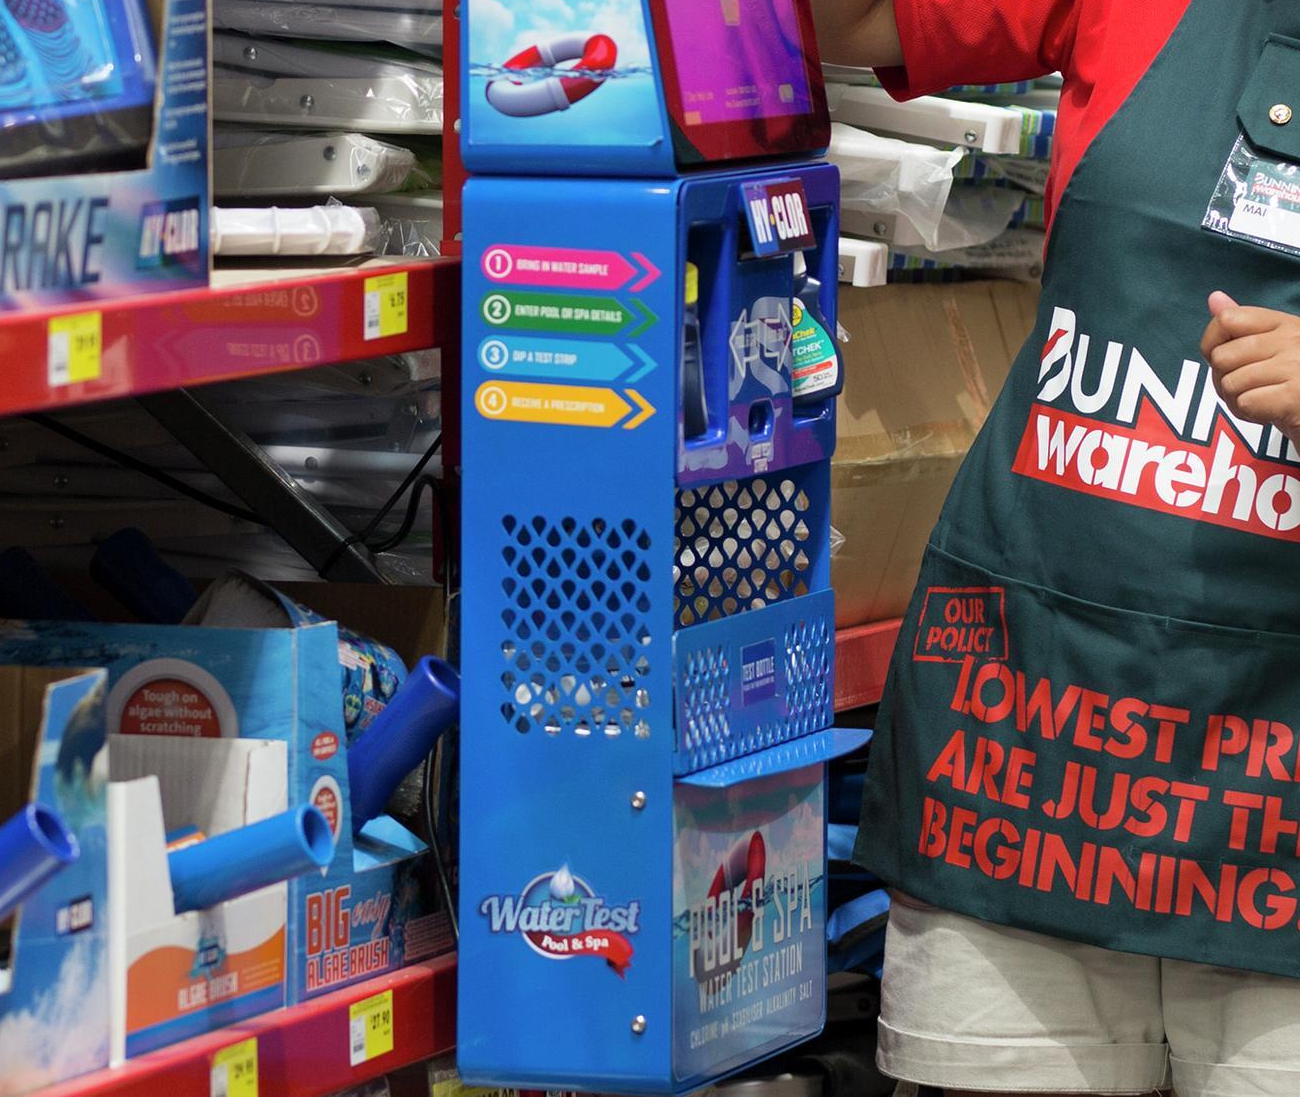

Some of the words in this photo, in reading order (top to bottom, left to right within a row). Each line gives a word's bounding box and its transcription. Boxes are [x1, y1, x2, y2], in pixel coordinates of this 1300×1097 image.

[1242, 204, 1267, 217] MAI
[0, 195, 111, 294] RAKE
[516, 258, 541, 271] BRING
[551, 260, 577, 274] WATER
[578, 262, 609, 277] SAMPLE
[514, 304, 540, 317] ENTER
[540, 305, 560, 319] POOL
[561, 306, 573, 319] OR
[574, 307, 590, 320] SPA
[590, 309, 622, 323] DETAILS
[512, 350, 526, 362] DIP
[535, 351, 553, 364] TEST
[554, 353, 577, 365] STRIP
[512, 396, 542, 409] RECEIVE
[551, 398, 605, 413] PRESCRIPTION
[944, 599, 986, 625] OUR
[926, 625, 994, 654] POLICY
[742, 662, 755, 682] TEST
[755, 655, 775, 679] BOTTLE
[143, 689, 178, 705] Tough
[182, 693, 198, 703] on
[951, 654, 1190, 764] LOWEST
[129, 706, 161, 721] algae
[164, 706, 212, 720] without
[140, 721, 202, 736] scratching
[926, 730, 1036, 810] ARE
[1042, 761, 1210, 844] JUST
[306, 884, 351, 956] BIG
[689, 886, 744, 978] POOL
[752, 877, 765, 952] &
[773, 864, 812, 944] SPA
[541, 935, 569, 953] Pool
[571, 938, 584, 950] &
[585, 935, 609, 952] Spa
[306, 955, 349, 992] ALGAE
[349, 936, 390, 976] BRUSH
[178, 981, 209, 1012] ALGAE
[209, 970, 240, 1001] BRUSH
[700, 972, 733, 1014] WATER
[736, 961, 760, 1000] TEST
[763, 942, 803, 989] STATION
[799, 980, 814, 1002] SALT
